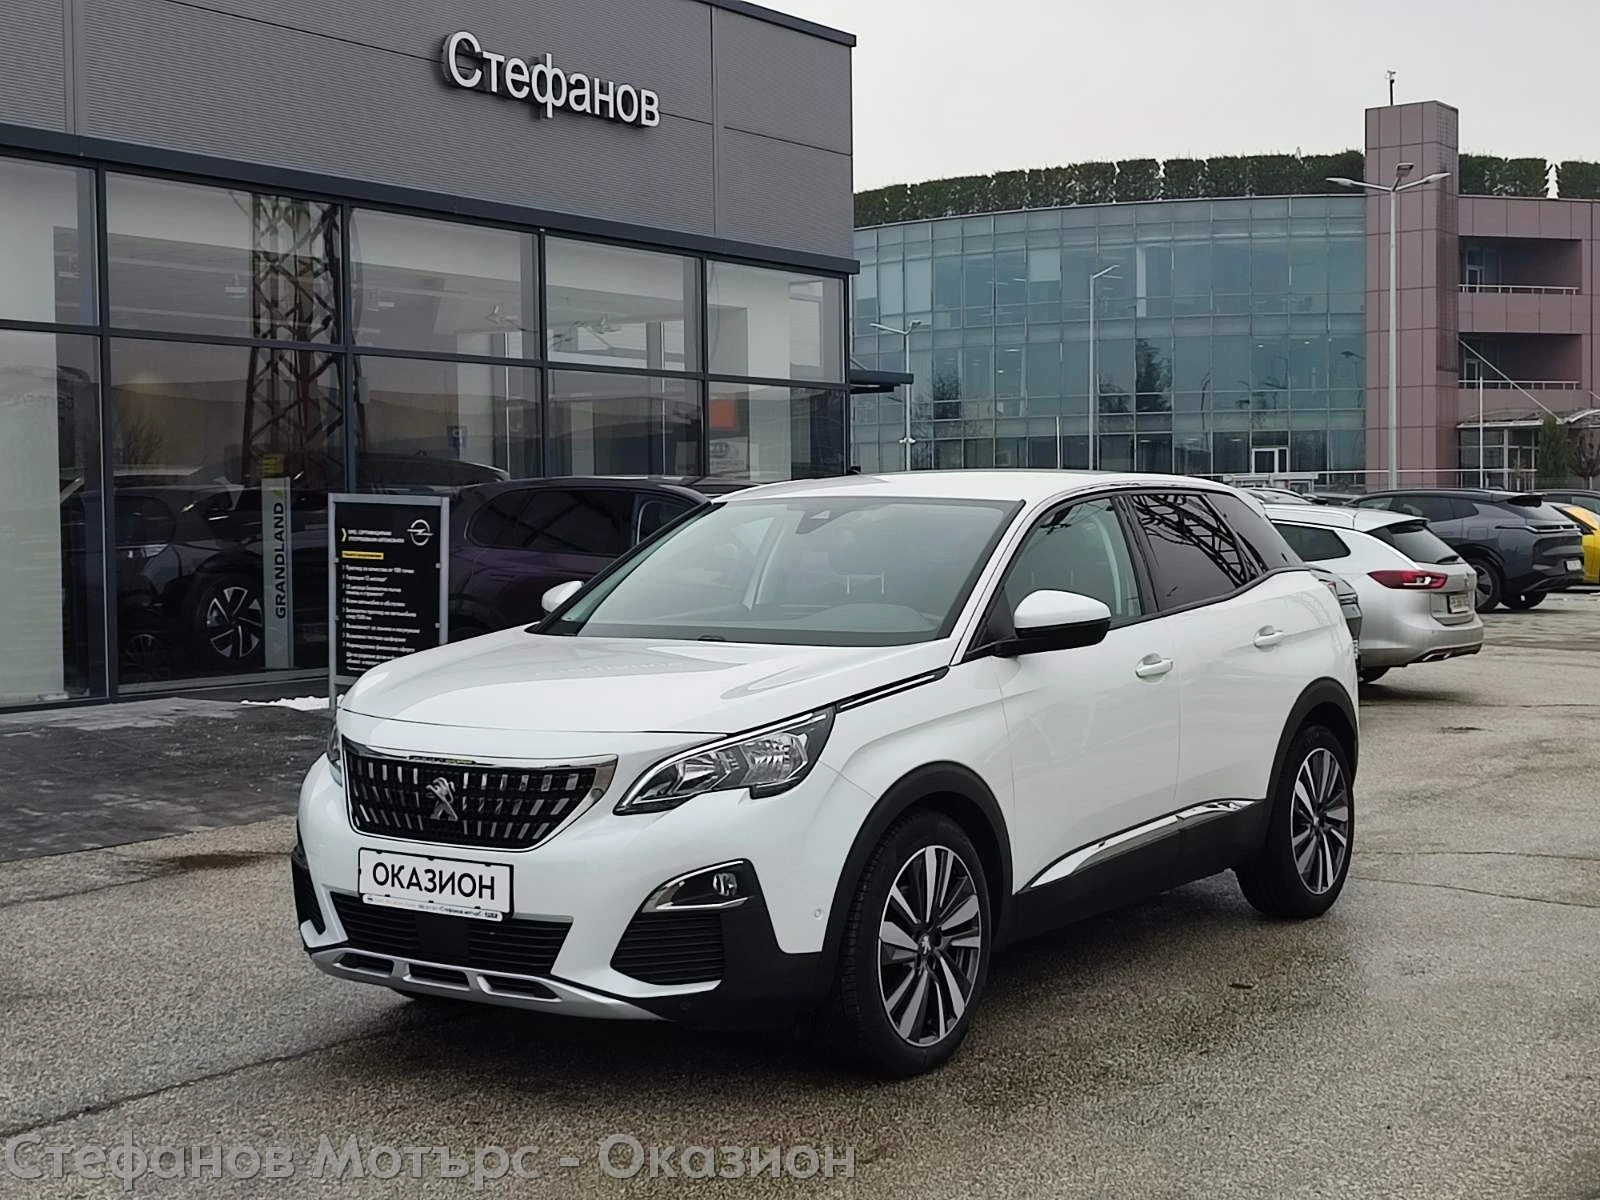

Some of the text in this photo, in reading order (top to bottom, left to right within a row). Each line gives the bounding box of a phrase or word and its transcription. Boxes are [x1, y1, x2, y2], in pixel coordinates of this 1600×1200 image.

[448, 31, 660, 127] Стефанов
[273, 502, 286, 619] GRANDLAND
[372, 861, 495, 900] ОКАЗИОН
